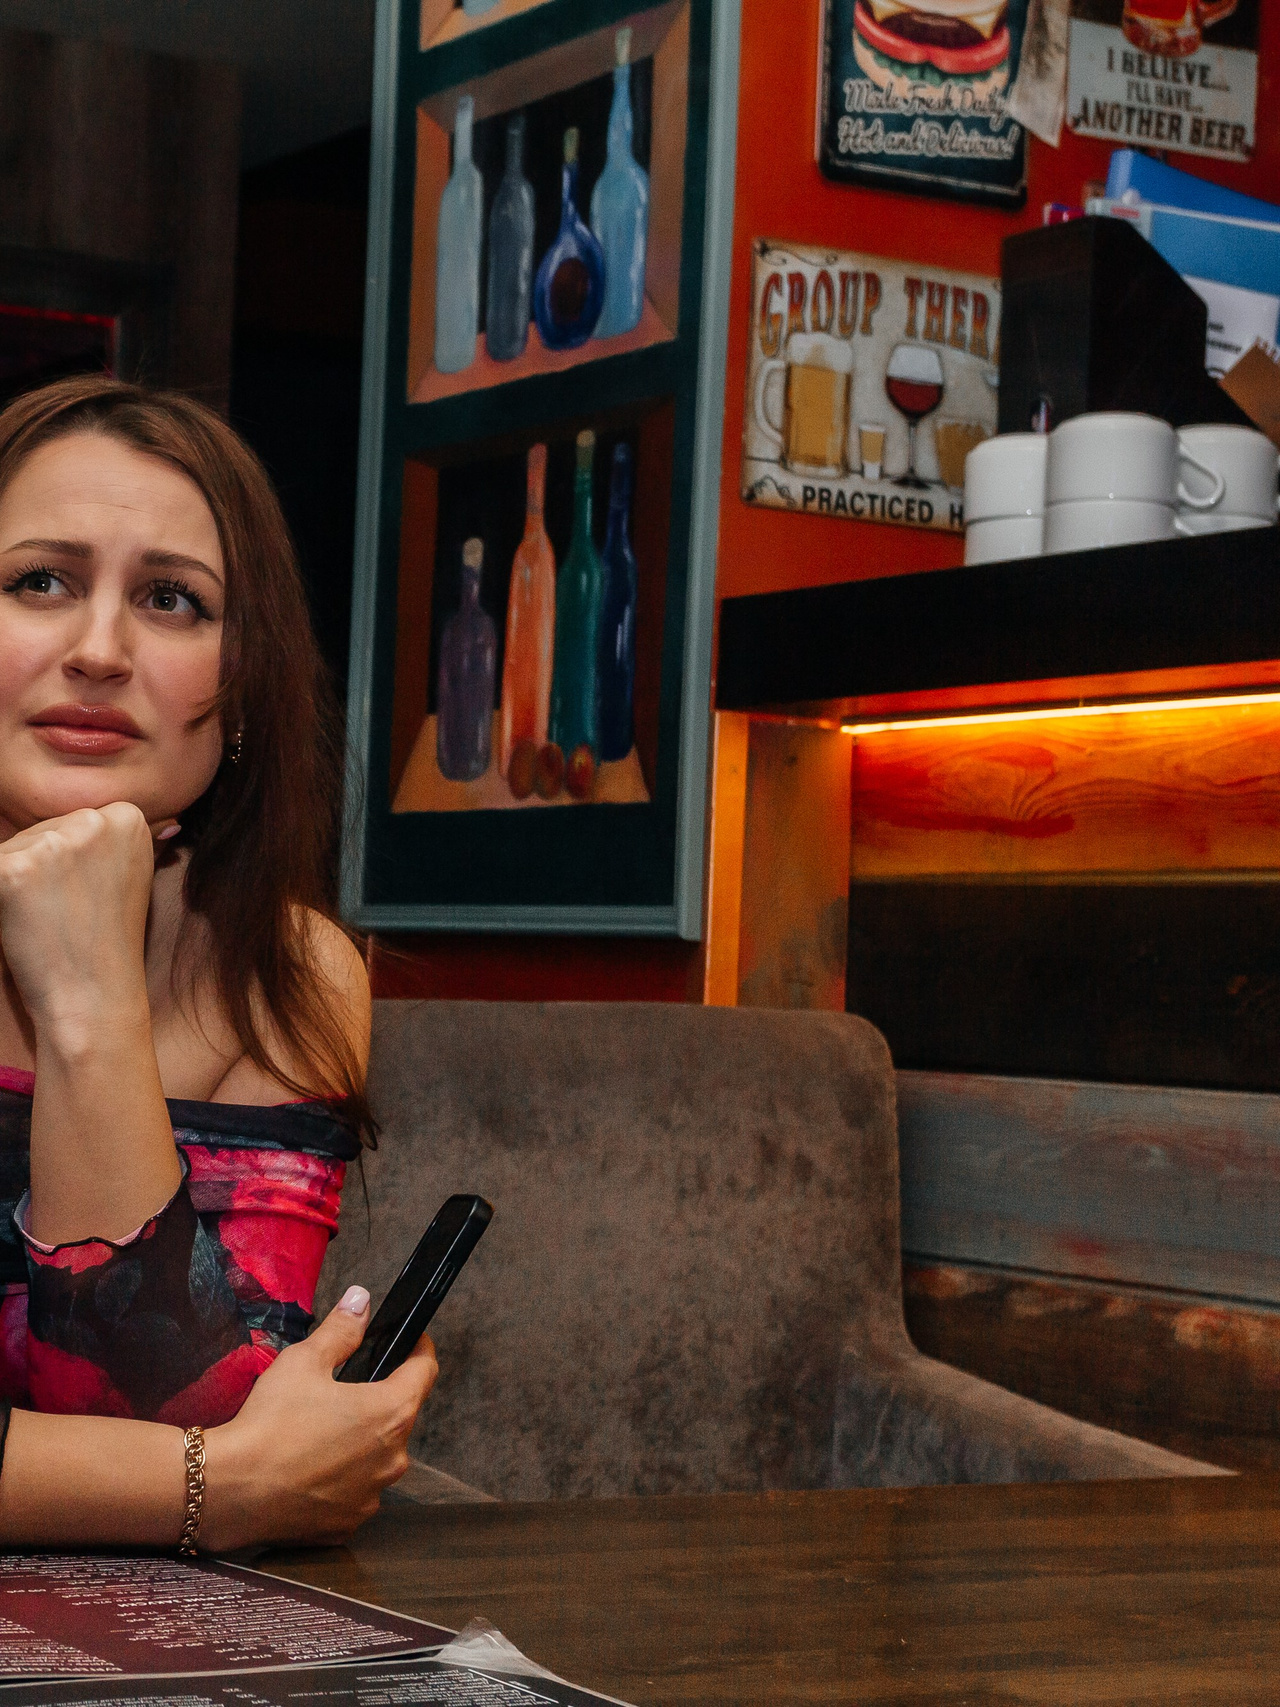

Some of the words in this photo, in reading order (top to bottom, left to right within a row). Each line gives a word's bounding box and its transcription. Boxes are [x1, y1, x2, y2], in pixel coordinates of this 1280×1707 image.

[1107, 46, 1114, 73] I
[844, 78, 901, 112] Made
[903, 79, 955, 115] Fresh
[838, 116, 884, 153] Hot
[885, 119, 923, 156] and
[923, 121, 1019, 160] Delicious!
[1076, 97, 1183, 144] ANOTHER
[1189, 115, 1247, 152] BEER
[760, 269, 882, 358] GROUP
[802, 485, 934, 524] PRACTICED
